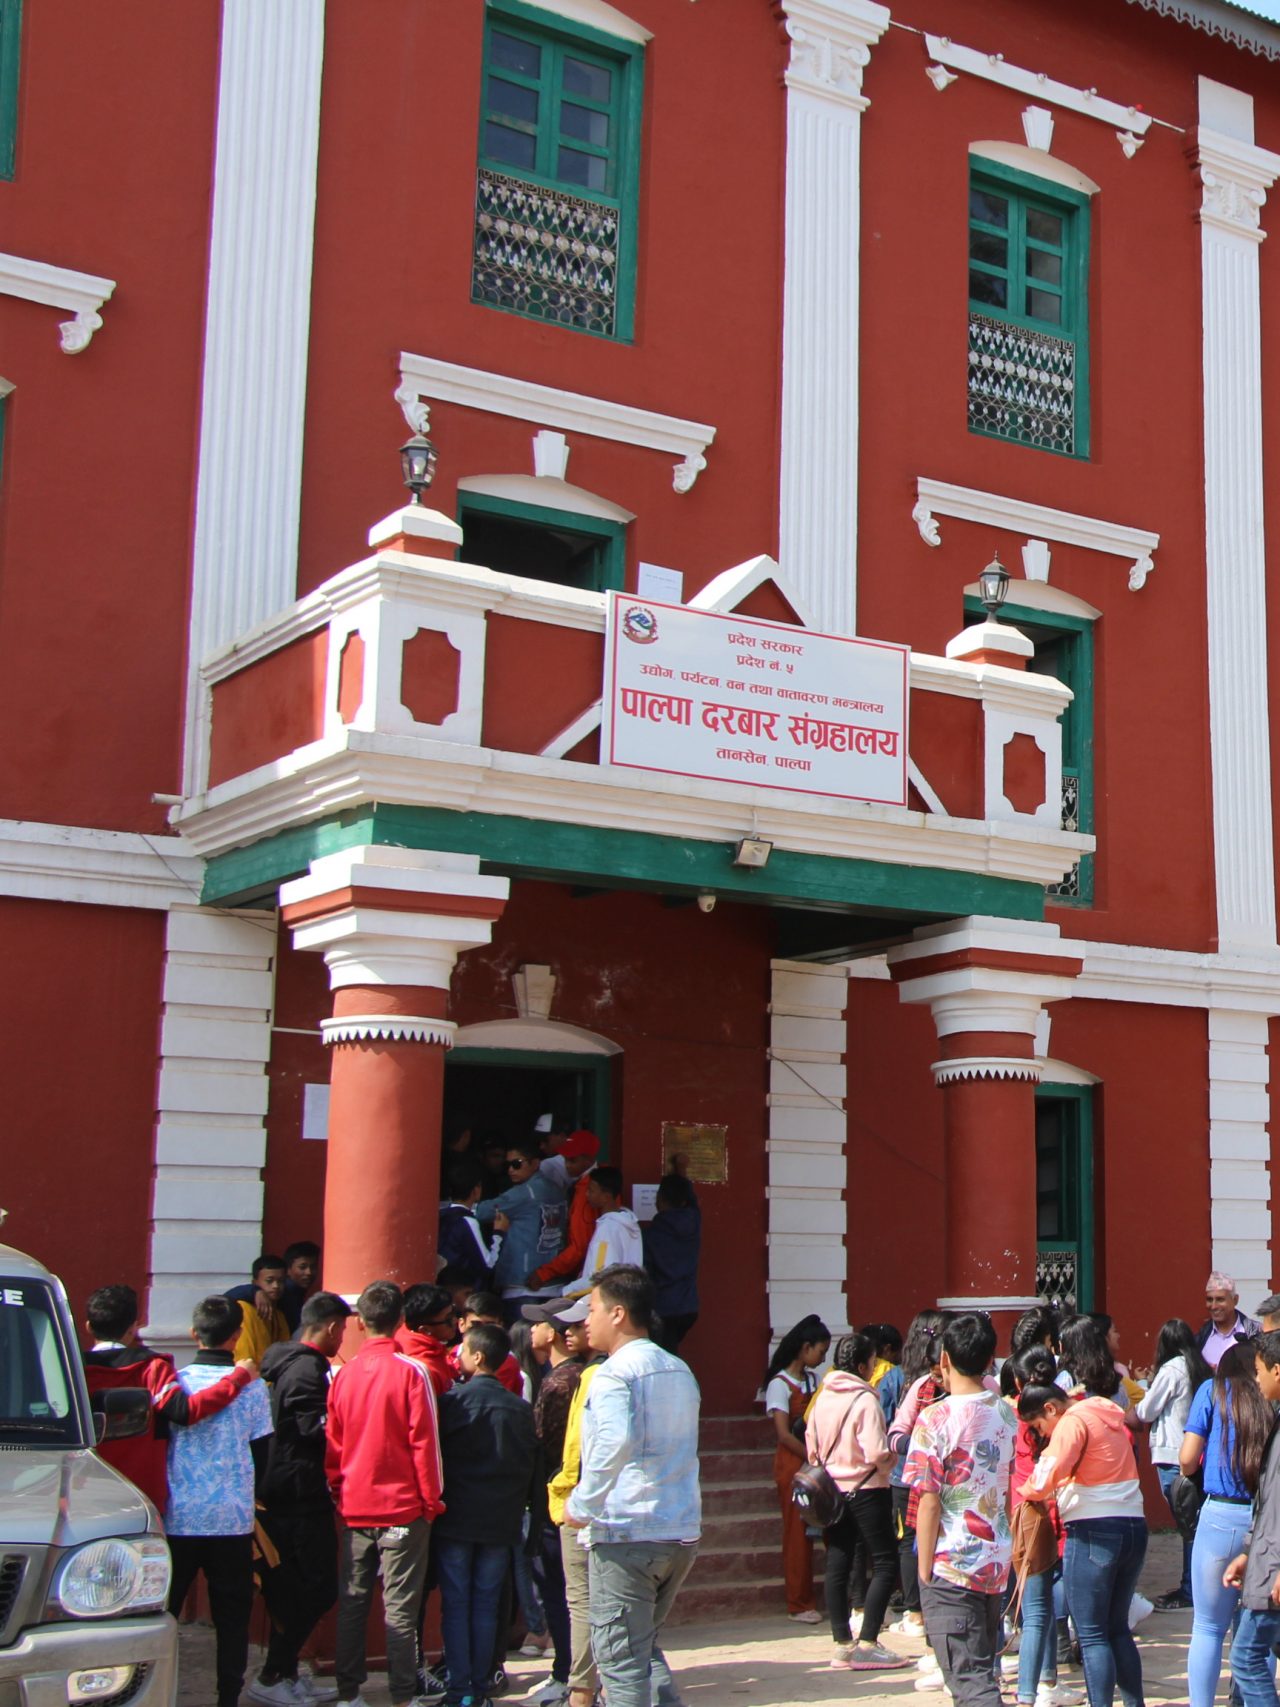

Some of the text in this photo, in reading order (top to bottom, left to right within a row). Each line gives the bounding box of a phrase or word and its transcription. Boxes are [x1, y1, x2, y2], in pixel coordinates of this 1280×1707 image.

[728, 632, 803, 656] प्रदेश सरकार
[736, 654, 765, 668] प्रदेश
[726, 680, 746, 691] वन
[749, 684, 773, 696] तथा
[777, 688, 828, 705] वातावरण
[621, 688, 899, 757] पाल्पा दरबार संग्रहालय
[775, 756, 812, 771] पाल्पा
